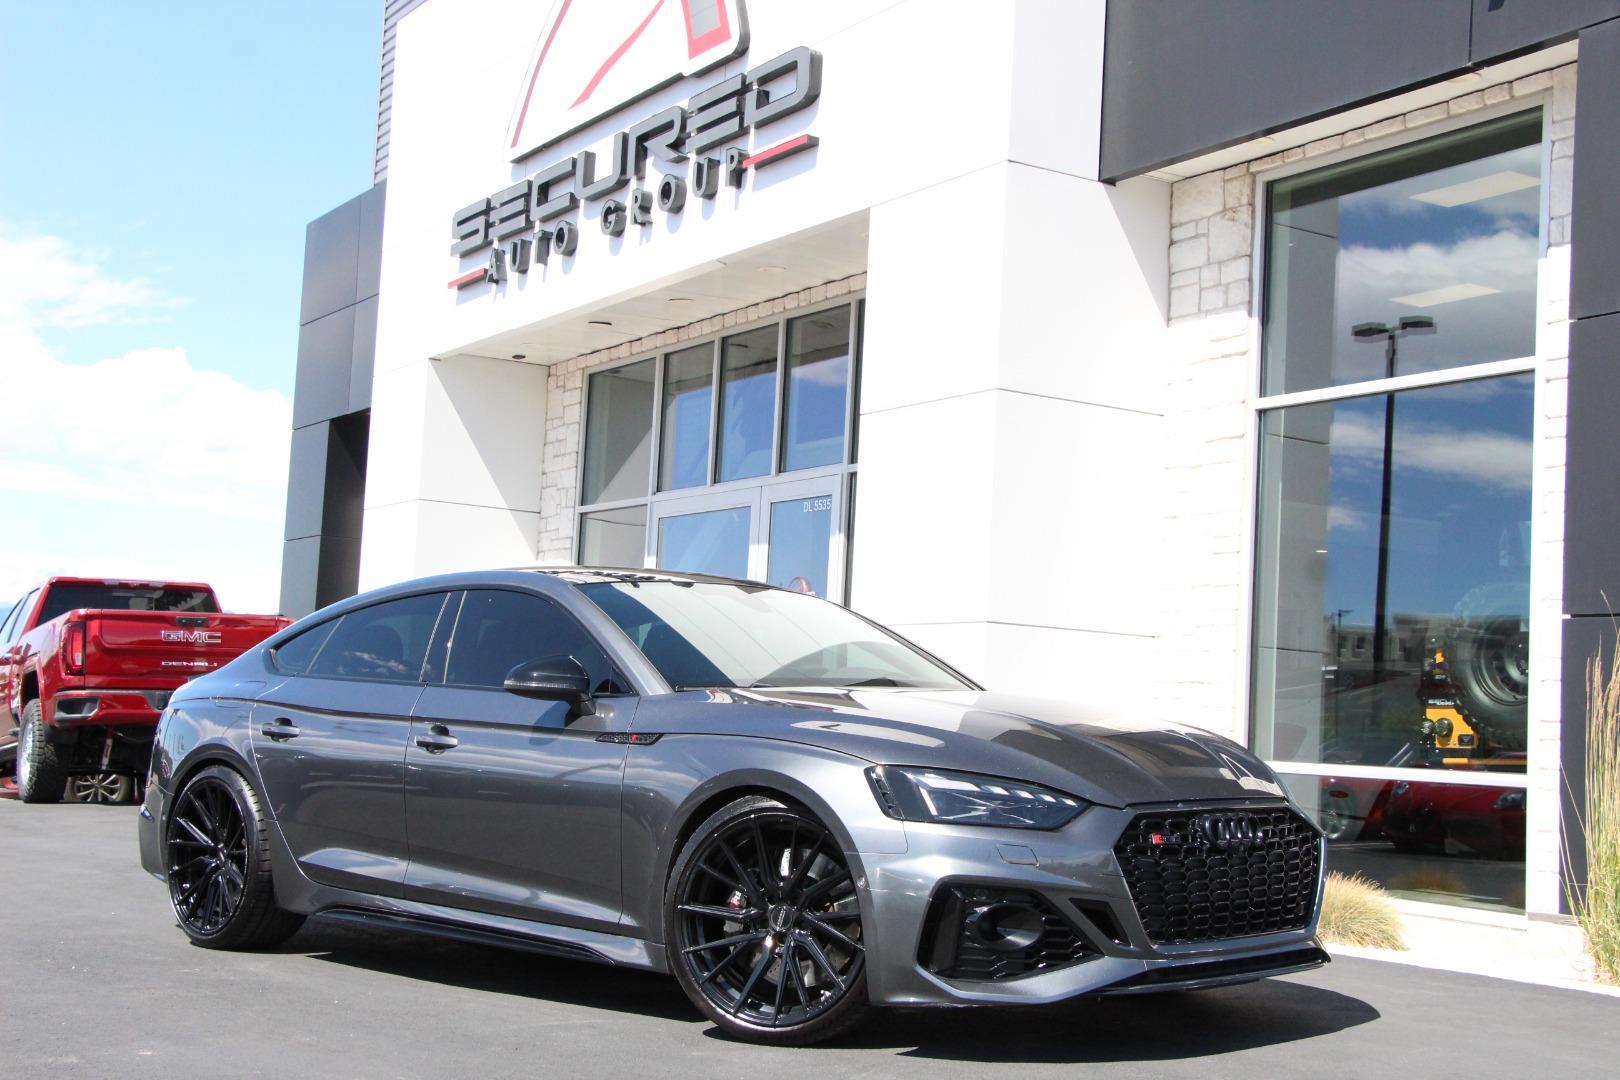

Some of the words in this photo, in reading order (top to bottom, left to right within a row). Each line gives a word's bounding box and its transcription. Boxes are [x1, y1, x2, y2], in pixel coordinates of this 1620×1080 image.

[451, 45, 823, 258] SECURED
[486, 219, 579, 286] AUTO
[600, 146, 747, 238] GROUP
[803, 501, 813, 513] DL
[814, 498, 832, 512] 5535
[161, 630, 222, 644] GMC
